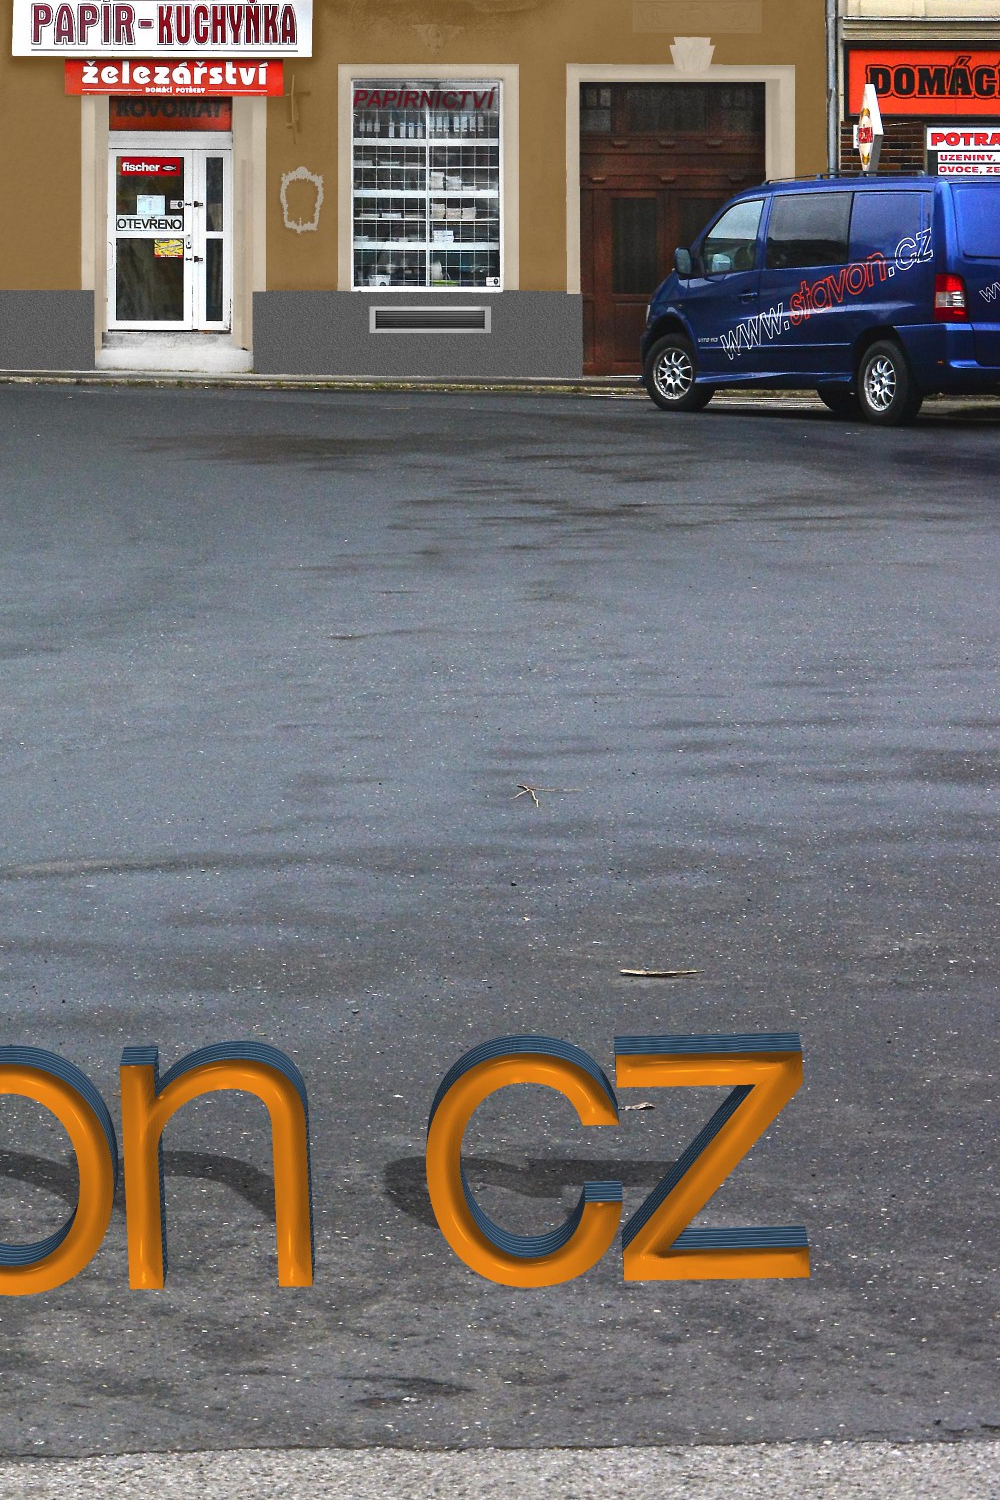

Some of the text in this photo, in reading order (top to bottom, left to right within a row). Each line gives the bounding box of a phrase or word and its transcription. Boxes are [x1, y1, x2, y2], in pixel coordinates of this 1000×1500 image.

[81, 60, 269, 86] železářství
[865, 56, 1000, 99] DOMÁC
[353, 86, 497, 110] PAPÍRNICTVÍ
[121, 162, 161, 172] fischer
[939, 154, 996, 162] UZENINY,
[939, 166, 982, 174] OVOCE,
[117, 216, 182, 230] OTEVŘENO
[720, 227, 934, 360] www.stavon.cz
